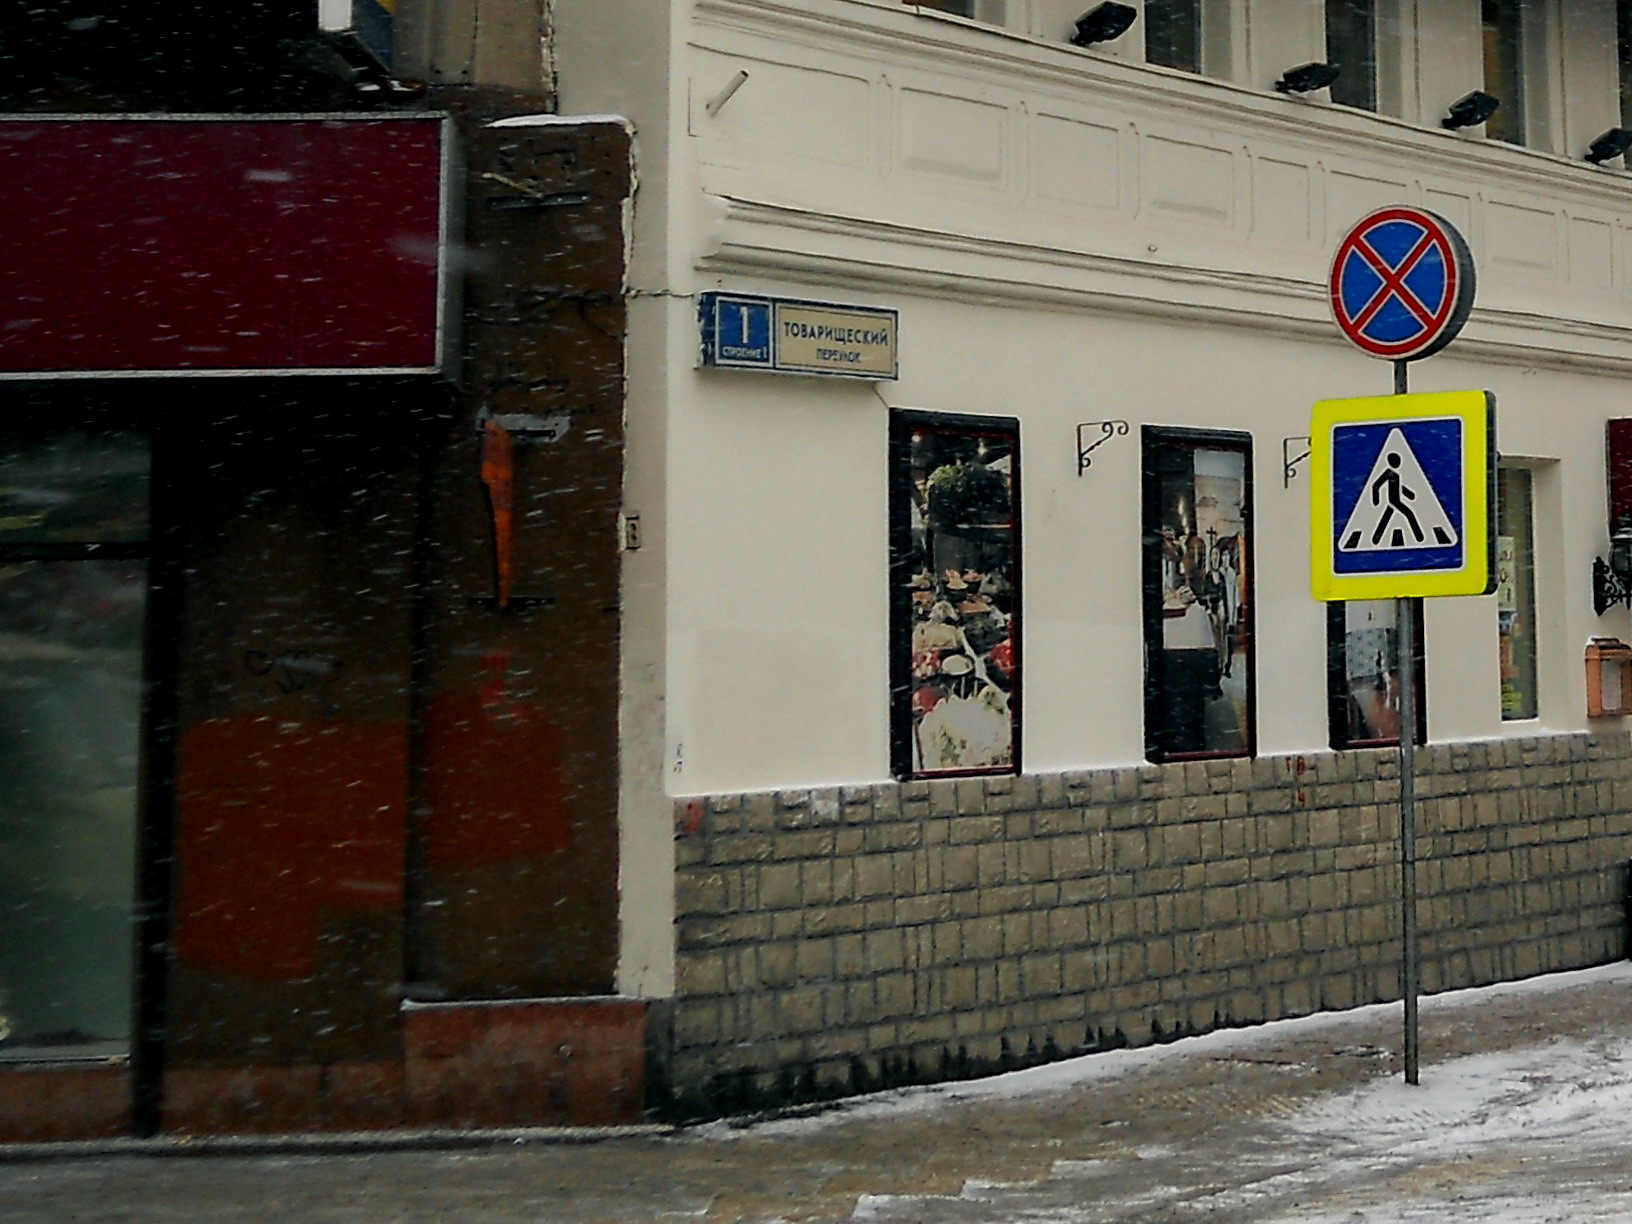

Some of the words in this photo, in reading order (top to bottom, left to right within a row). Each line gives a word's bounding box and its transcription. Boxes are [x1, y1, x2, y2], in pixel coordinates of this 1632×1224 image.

[739, 305, 749, 345] 1
[783, 320, 889, 347] ТОВАРИЩЕСКИЙ
[721, 345, 763, 360] СТРОЕНИЕ
[815, 347, 862, 364] ПЕРЕУЛОК
